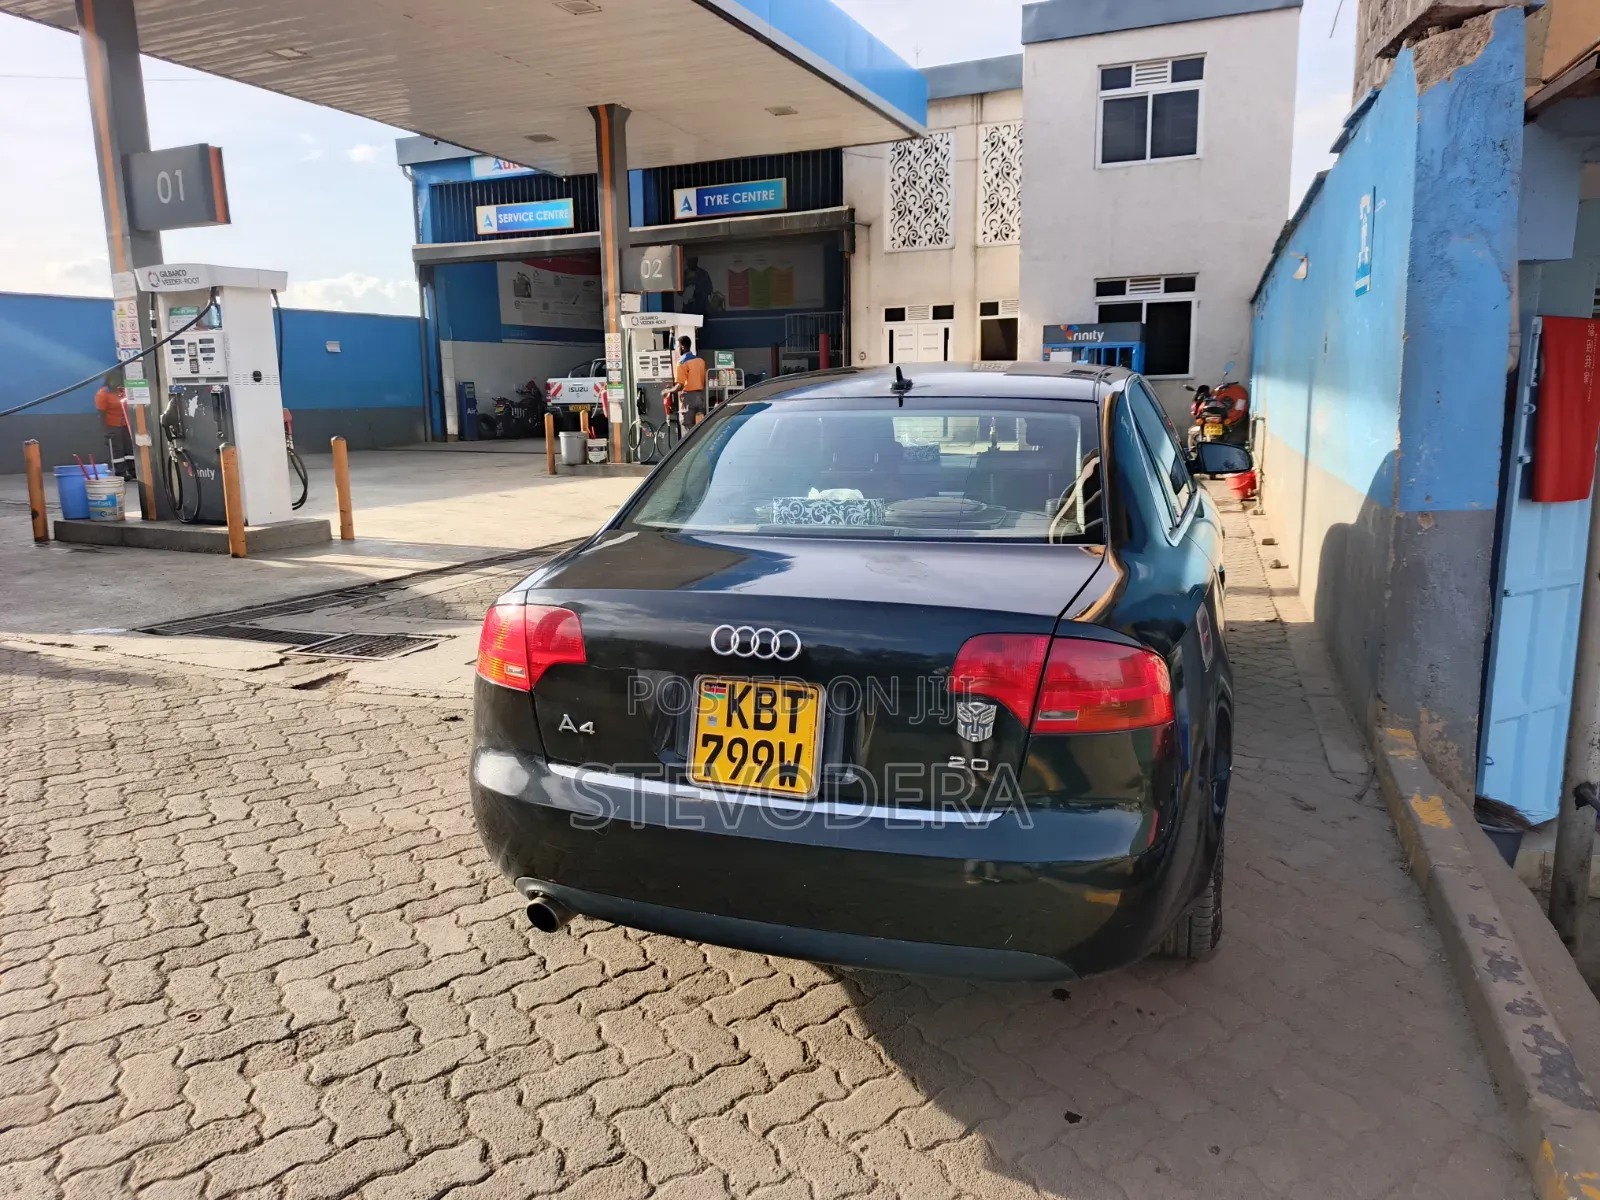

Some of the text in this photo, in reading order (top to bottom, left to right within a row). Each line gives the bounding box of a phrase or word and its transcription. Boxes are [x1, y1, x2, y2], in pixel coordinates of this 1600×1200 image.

[157, 169, 185, 204] 01
[704, 194, 729, 206] TYRE
[732, 190, 775, 204] CENTRE
[498, 211, 534, 224] SERVICE
[536, 209, 569, 221] CENTRE
[160, 269, 187, 278] GILBARCO
[641, 259, 663, 278] 02
[161, 277, 200, 286] VEEDER-ROOT
[726, 684, 808, 734] KBT
[558, 713, 596, 735] A4
[701, 733, 803, 788] 799W
